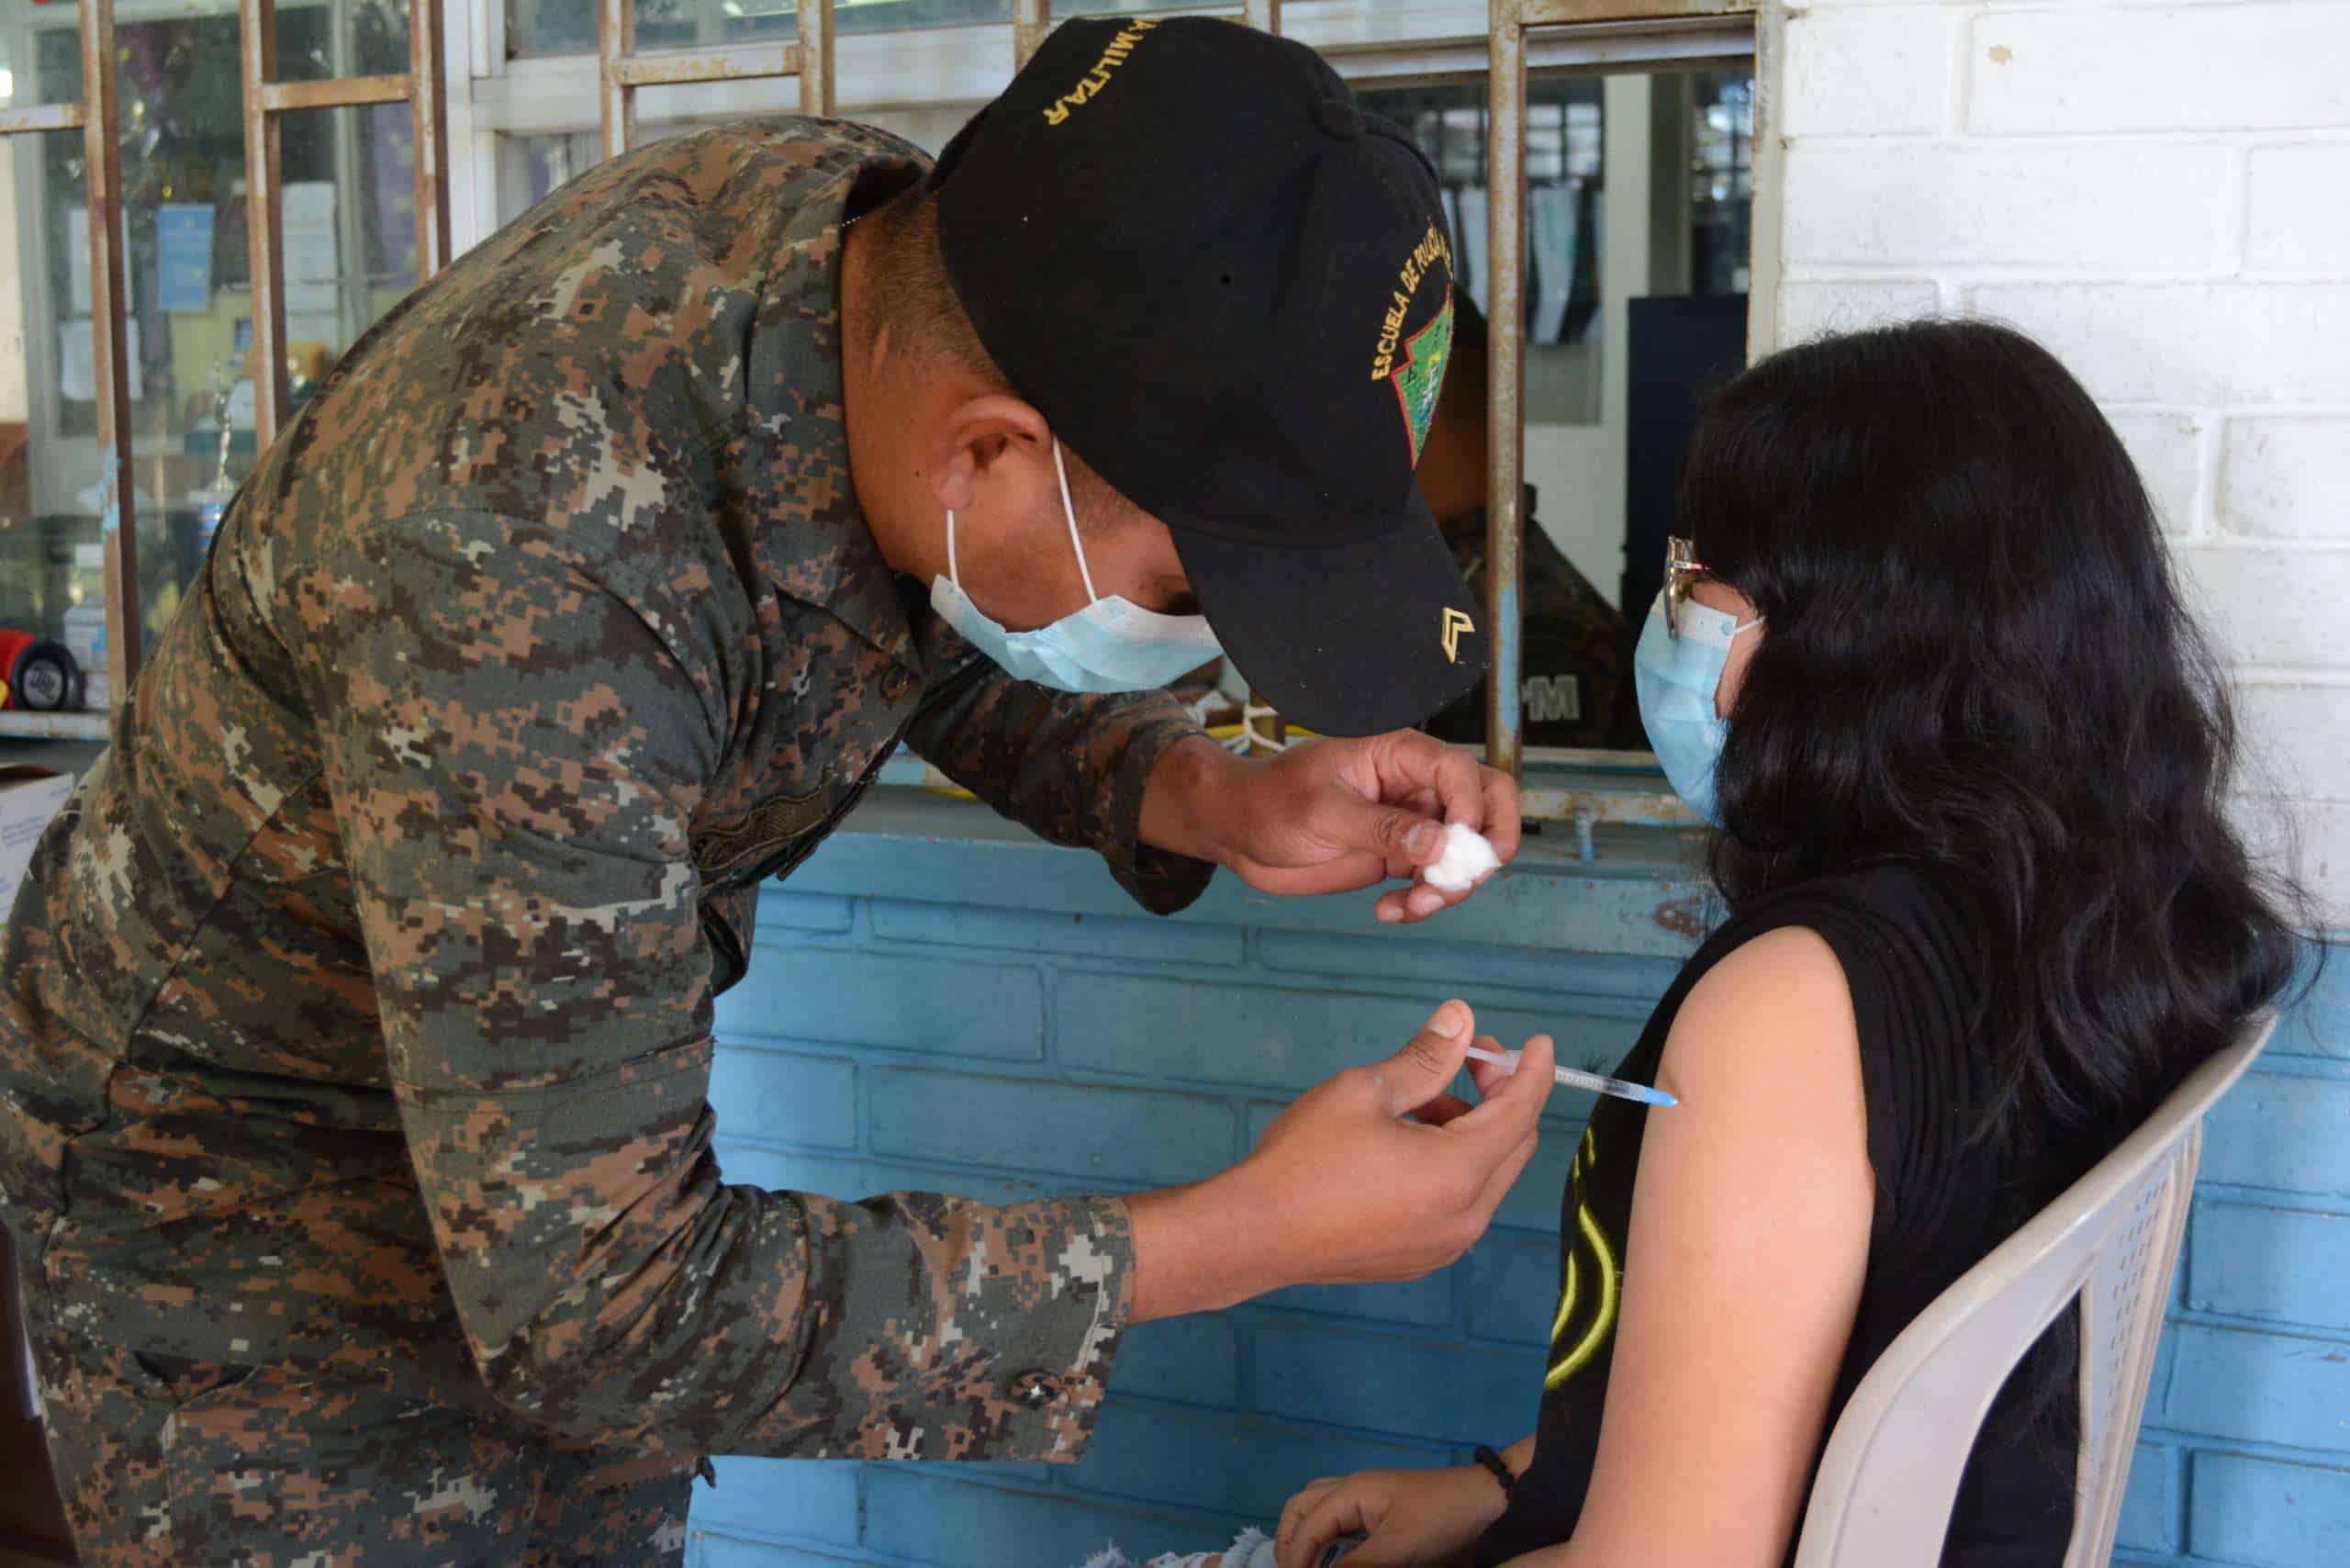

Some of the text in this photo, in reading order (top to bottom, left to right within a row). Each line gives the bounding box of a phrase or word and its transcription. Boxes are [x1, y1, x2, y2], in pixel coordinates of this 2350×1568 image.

[1043, 31, 1145, 126] MILITAR
[1371, 291, 1410, 381] ESCUELA
[1400, 257, 1420, 294] DE
